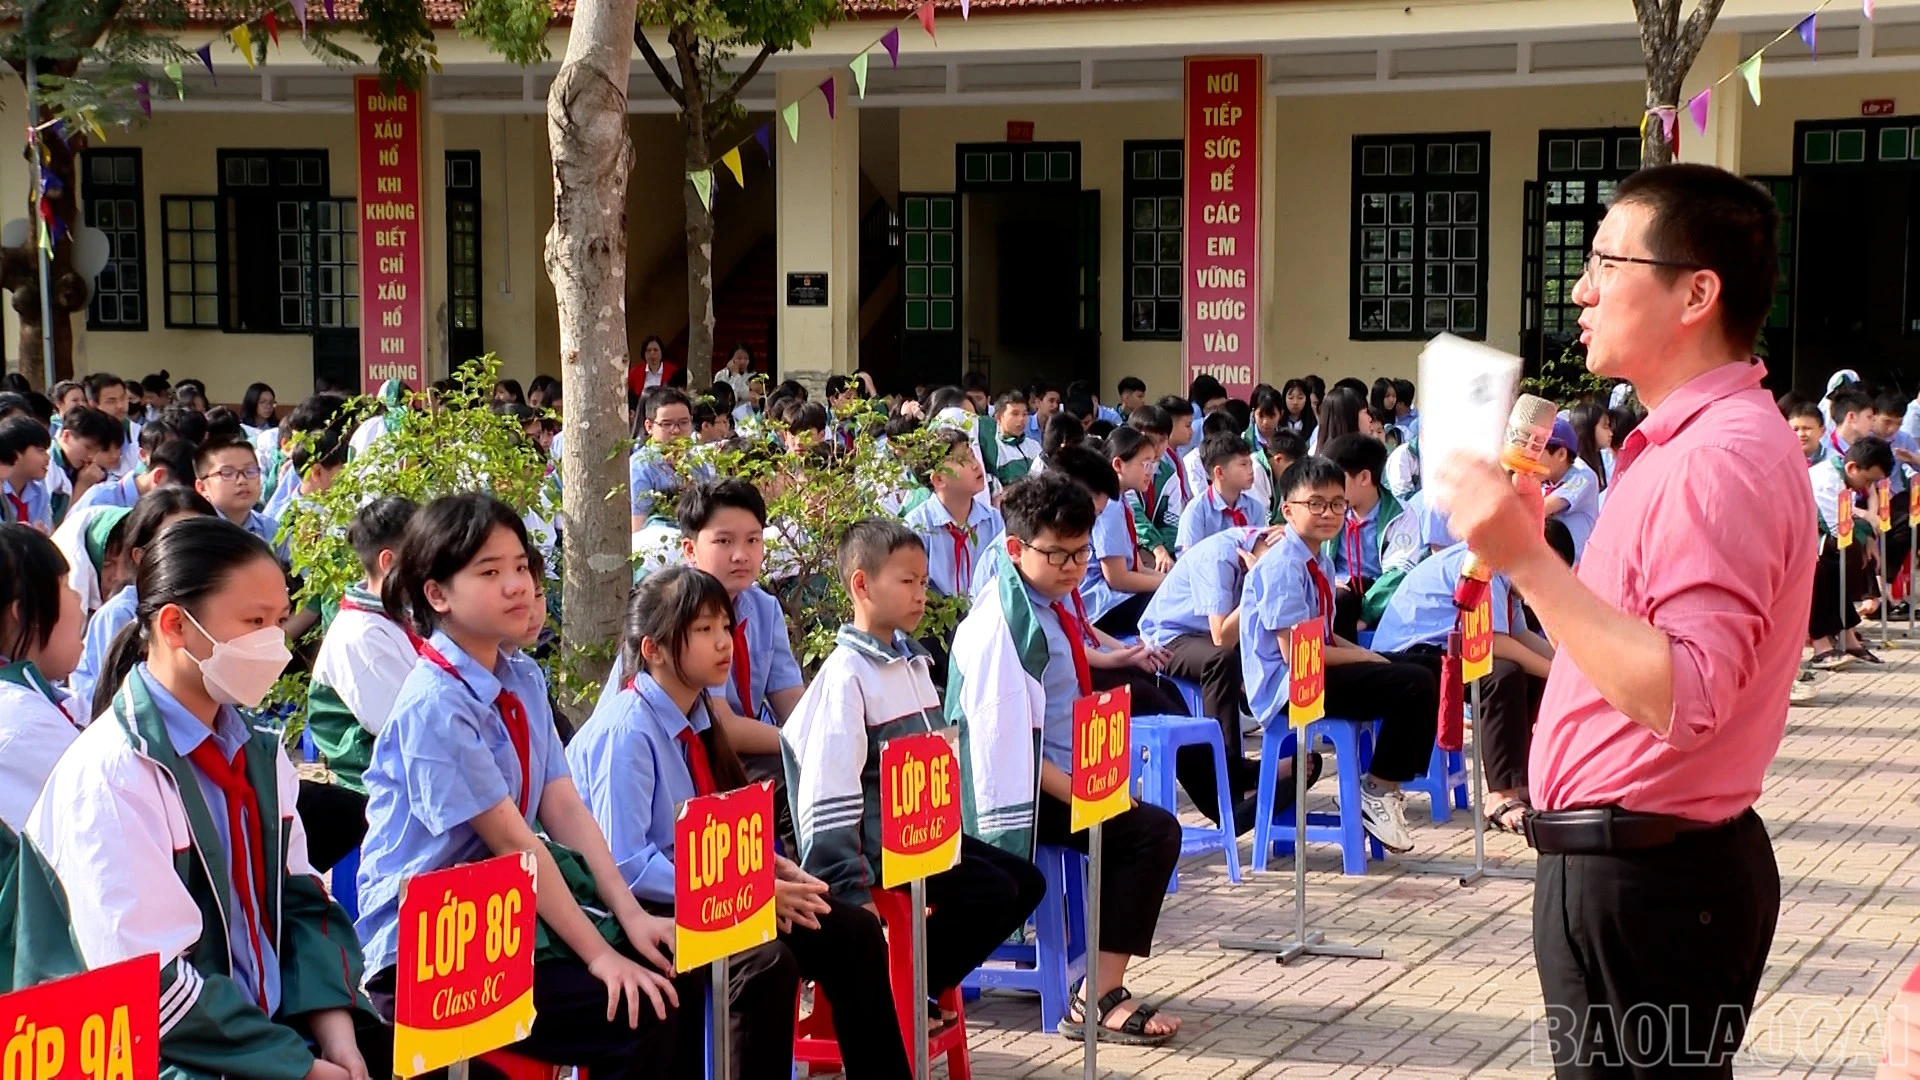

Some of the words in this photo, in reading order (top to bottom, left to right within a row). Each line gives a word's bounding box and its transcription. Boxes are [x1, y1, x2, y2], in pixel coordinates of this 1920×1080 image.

[1207, 73, 1239, 93] NƠI
[1203, 101, 1242, 126] TIẾP
[1204, 136, 1241, 159] SỨC
[377, 177, 401, 193] KHI
[1210, 164, 1235, 192] ĐỂ
[366, 202, 415, 220] KHÔNG
[1203, 201, 1241, 224] CÁC
[375, 226, 406, 246] BIẾT
[1207, 237, 1235, 256] EM
[379, 252, 404, 274] CHỈ
[1196, 265, 1246, 289] VỮNG
[377, 279, 406, 300] XẤU
[383, 305, 402, 328] HỔ
[1197, 298, 1246, 320] BƯỚC
[380, 338, 404, 354] KHI
[1203, 330, 1239, 352] VÀO
[368, 361, 418, 380] KHÔNG
[1294, 634, 1310, 681] LỚP
[1311, 635, 1321, 676] 6C
[1080, 709, 1107, 770] LỚP
[1109, 710, 1125, 760] 6D
[891, 751, 926, 819] LỚP
[930, 753, 951, 809] 6E
[1087, 773, 1107, 796] Class
[901, 823, 928, 848] Class
[930, 816, 944, 840] 6E
[689, 813, 731, 892] LỚP
[736, 812, 763, 877] 6G
[701, 895, 733, 925] Class
[735, 883, 754, 913] 6G
[417, 889, 477, 982] LỚP
[485, 887, 522, 963] 8C
[432, 985, 478, 1021] Class
[481, 971, 506, 1006] 8C
[2, 1015, 65, 1080] ỚP
[80, 1005, 134, 1080] 9A
